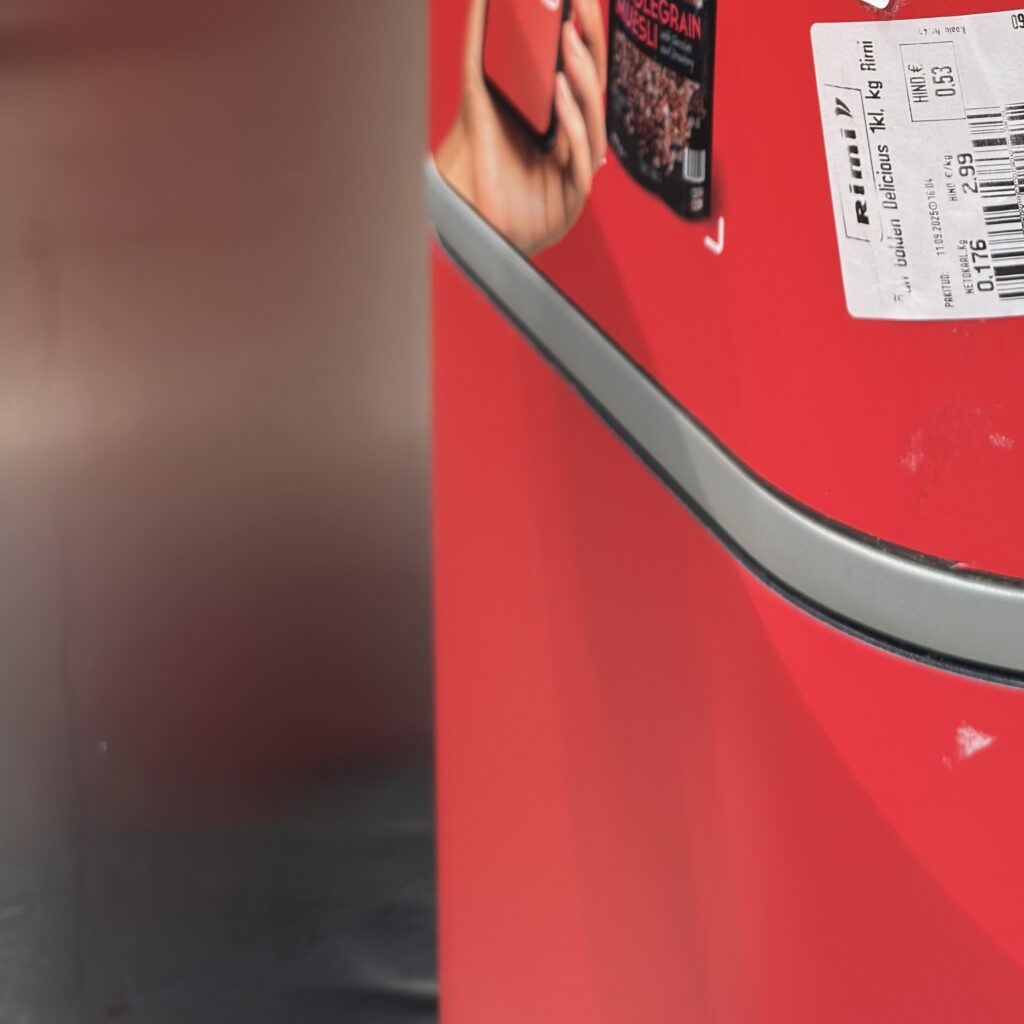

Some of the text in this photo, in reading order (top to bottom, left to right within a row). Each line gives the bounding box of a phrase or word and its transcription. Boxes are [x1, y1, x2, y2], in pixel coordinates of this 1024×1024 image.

[857, 41, 876, 71] Rimi
[865, 81, 883, 99] kg
[908, 65, 928, 102] HIND,€
[931, 66, 956, 97] 0,53
[868, 109, 886, 133] 1kl,
[841, 130, 869, 224] Rimi
[878, 145, 898, 209] Delicious
[957, 153, 978, 193] 2,99
[970, 240, 994, 291] 0,176
